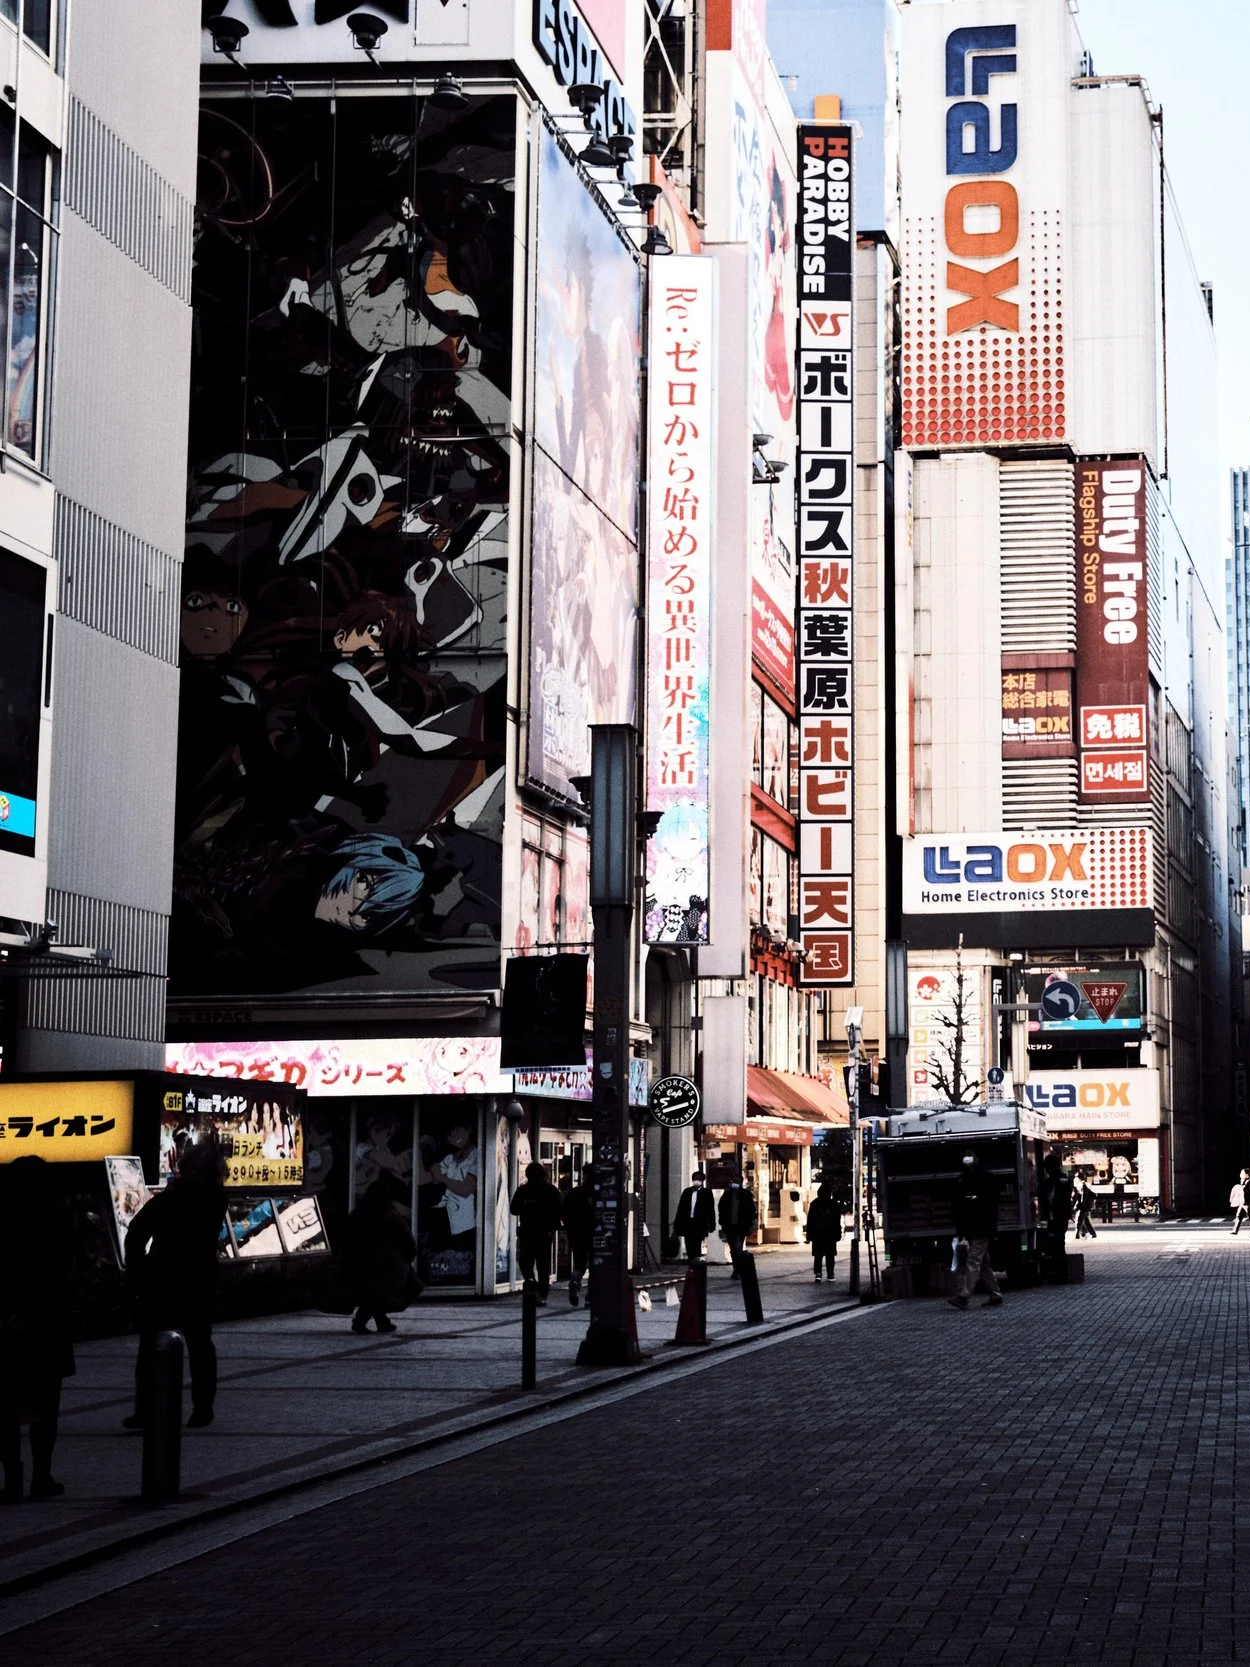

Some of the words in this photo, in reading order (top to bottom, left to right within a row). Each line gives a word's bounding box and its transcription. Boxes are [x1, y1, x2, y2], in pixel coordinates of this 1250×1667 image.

[825, 136, 850, 241] HOBBY
[803, 136, 825, 294] PARADISE
[1080, 471, 1100, 546] Flagship
[1099, 469, 1142, 554] Duty
[660, 286, 702, 786] Re:ゼロから始める異世界生活
[1083, 552, 1100, 604] Store
[1103, 562, 1143, 645] Free
[1002, 673, 1036, 690] 本店
[1002, 690, 1069, 709] 総合家電
[1087, 713, 1140, 739] 免税
[1086, 761, 1142, 782] 면세점
[921, 891, 962, 902] Home
[967, 889, 1045, 901] Electronics
[1050, 888, 1089, 899] Store
[1091, 987, 1118, 996] 止まれ
[1095, 997, 1115, 1006] STOP
[654, 1079, 695, 1096] SMOKER'S
[1079, 1111, 1101, 1119] MAIN
[1103, 1111, 1132, 1119] STORE
